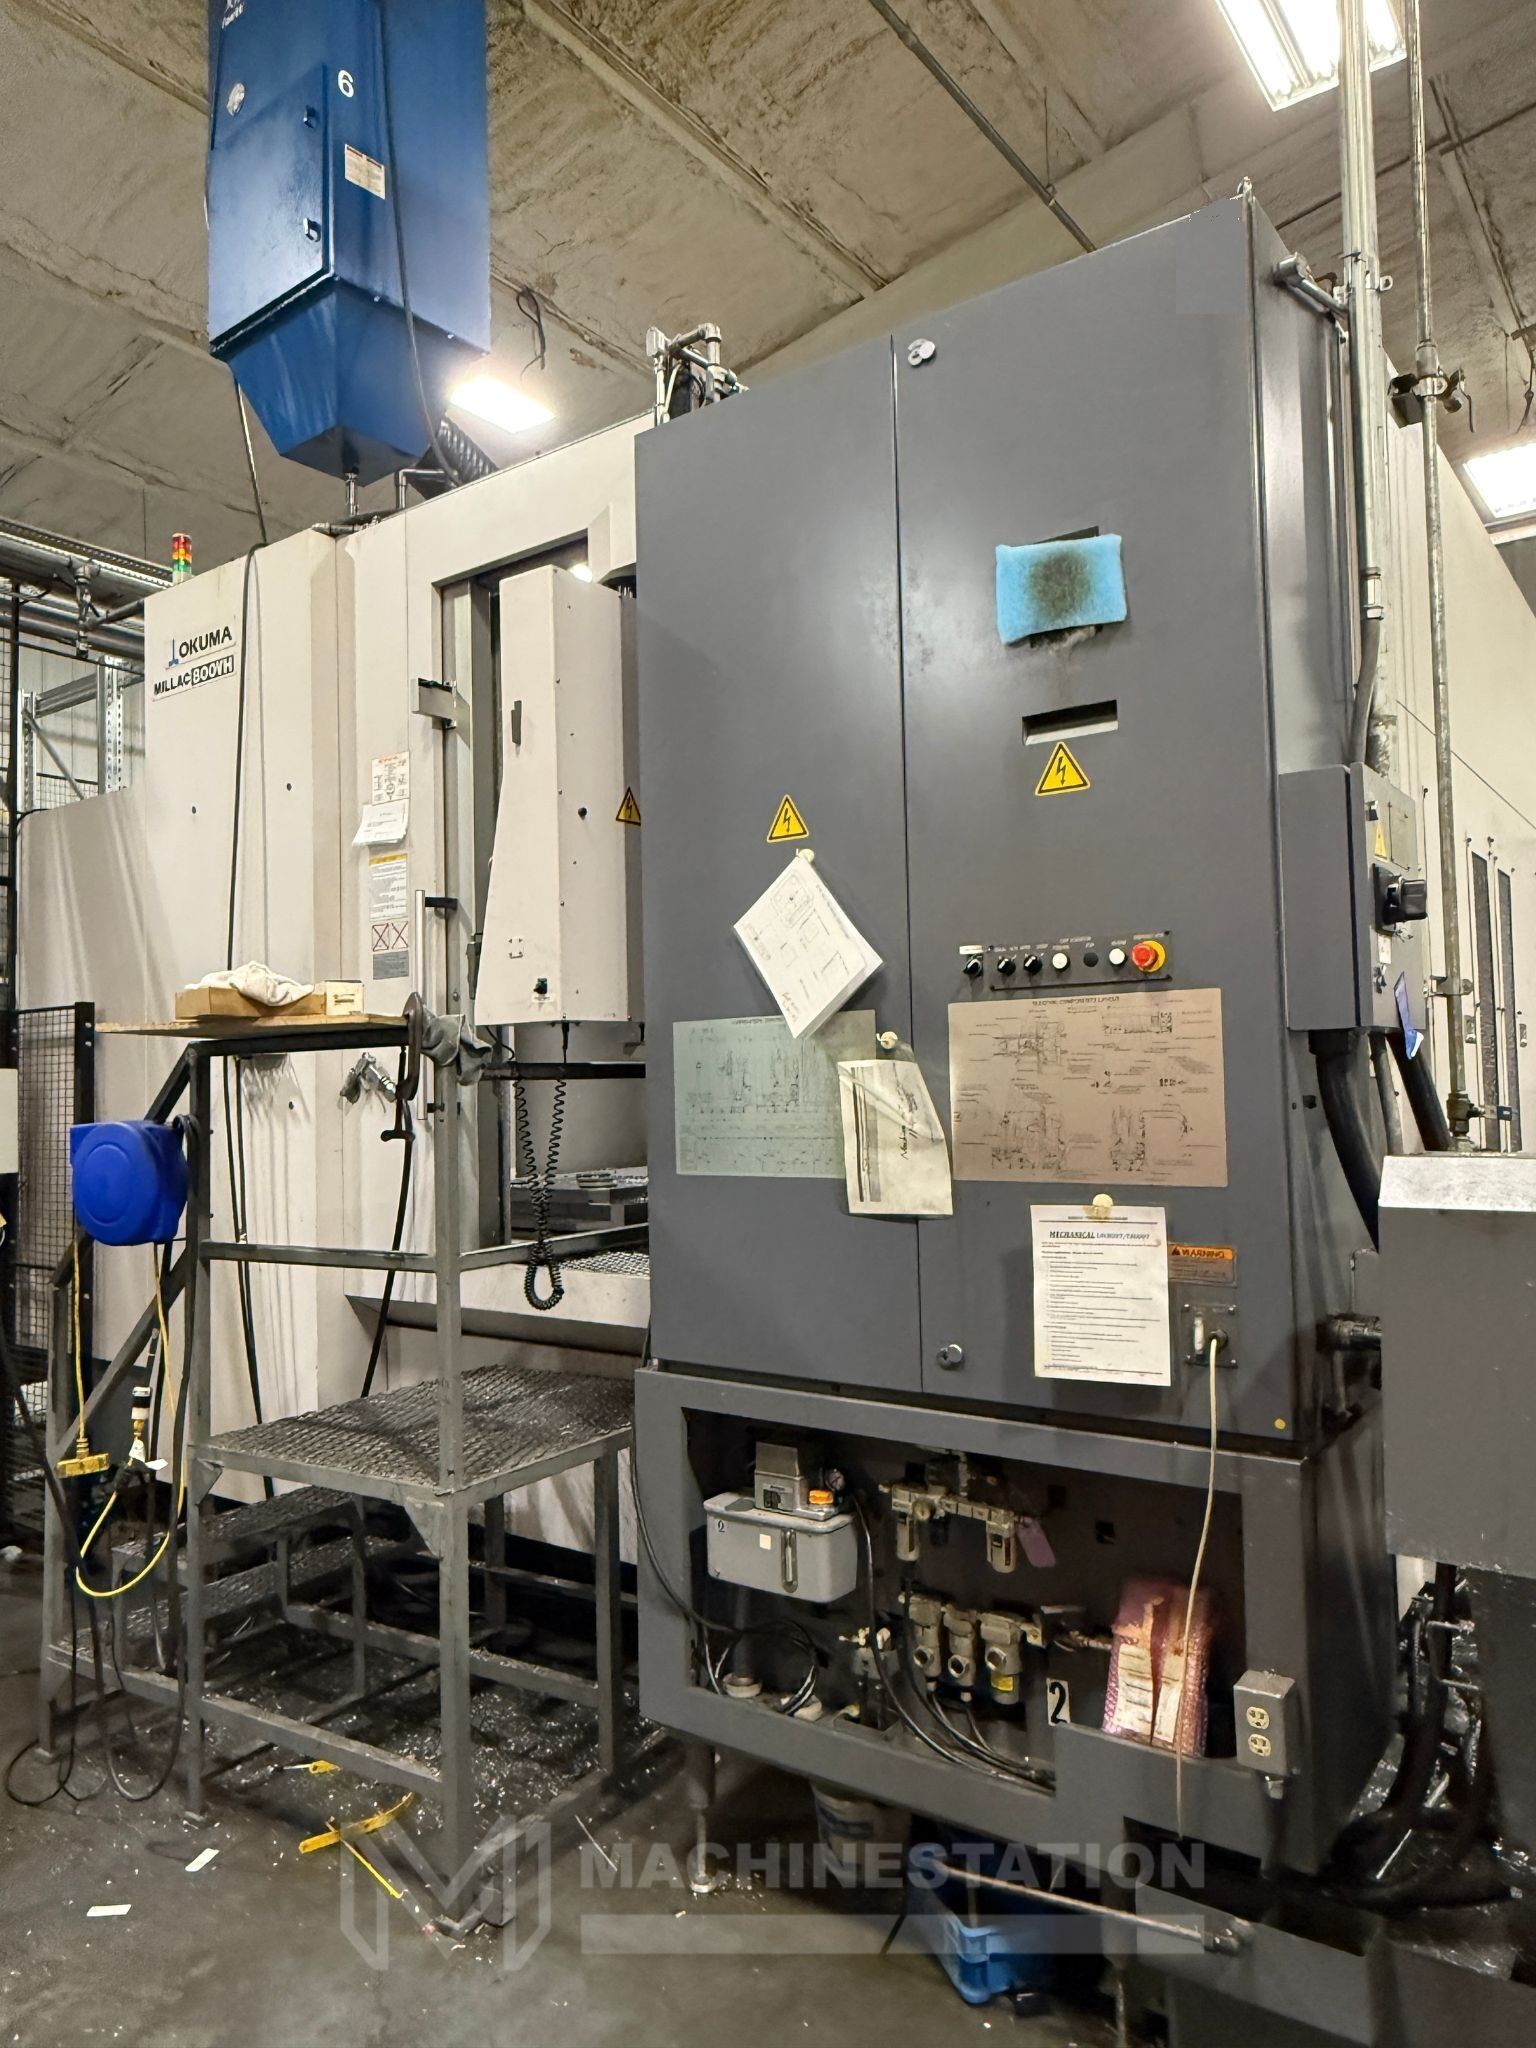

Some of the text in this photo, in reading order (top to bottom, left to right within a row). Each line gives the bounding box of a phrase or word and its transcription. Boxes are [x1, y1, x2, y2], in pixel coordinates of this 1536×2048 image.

[338, 69, 355, 98] 6
[178, 625, 233, 659] OKUMA
[1048, 1681, 1068, 1725] 2
